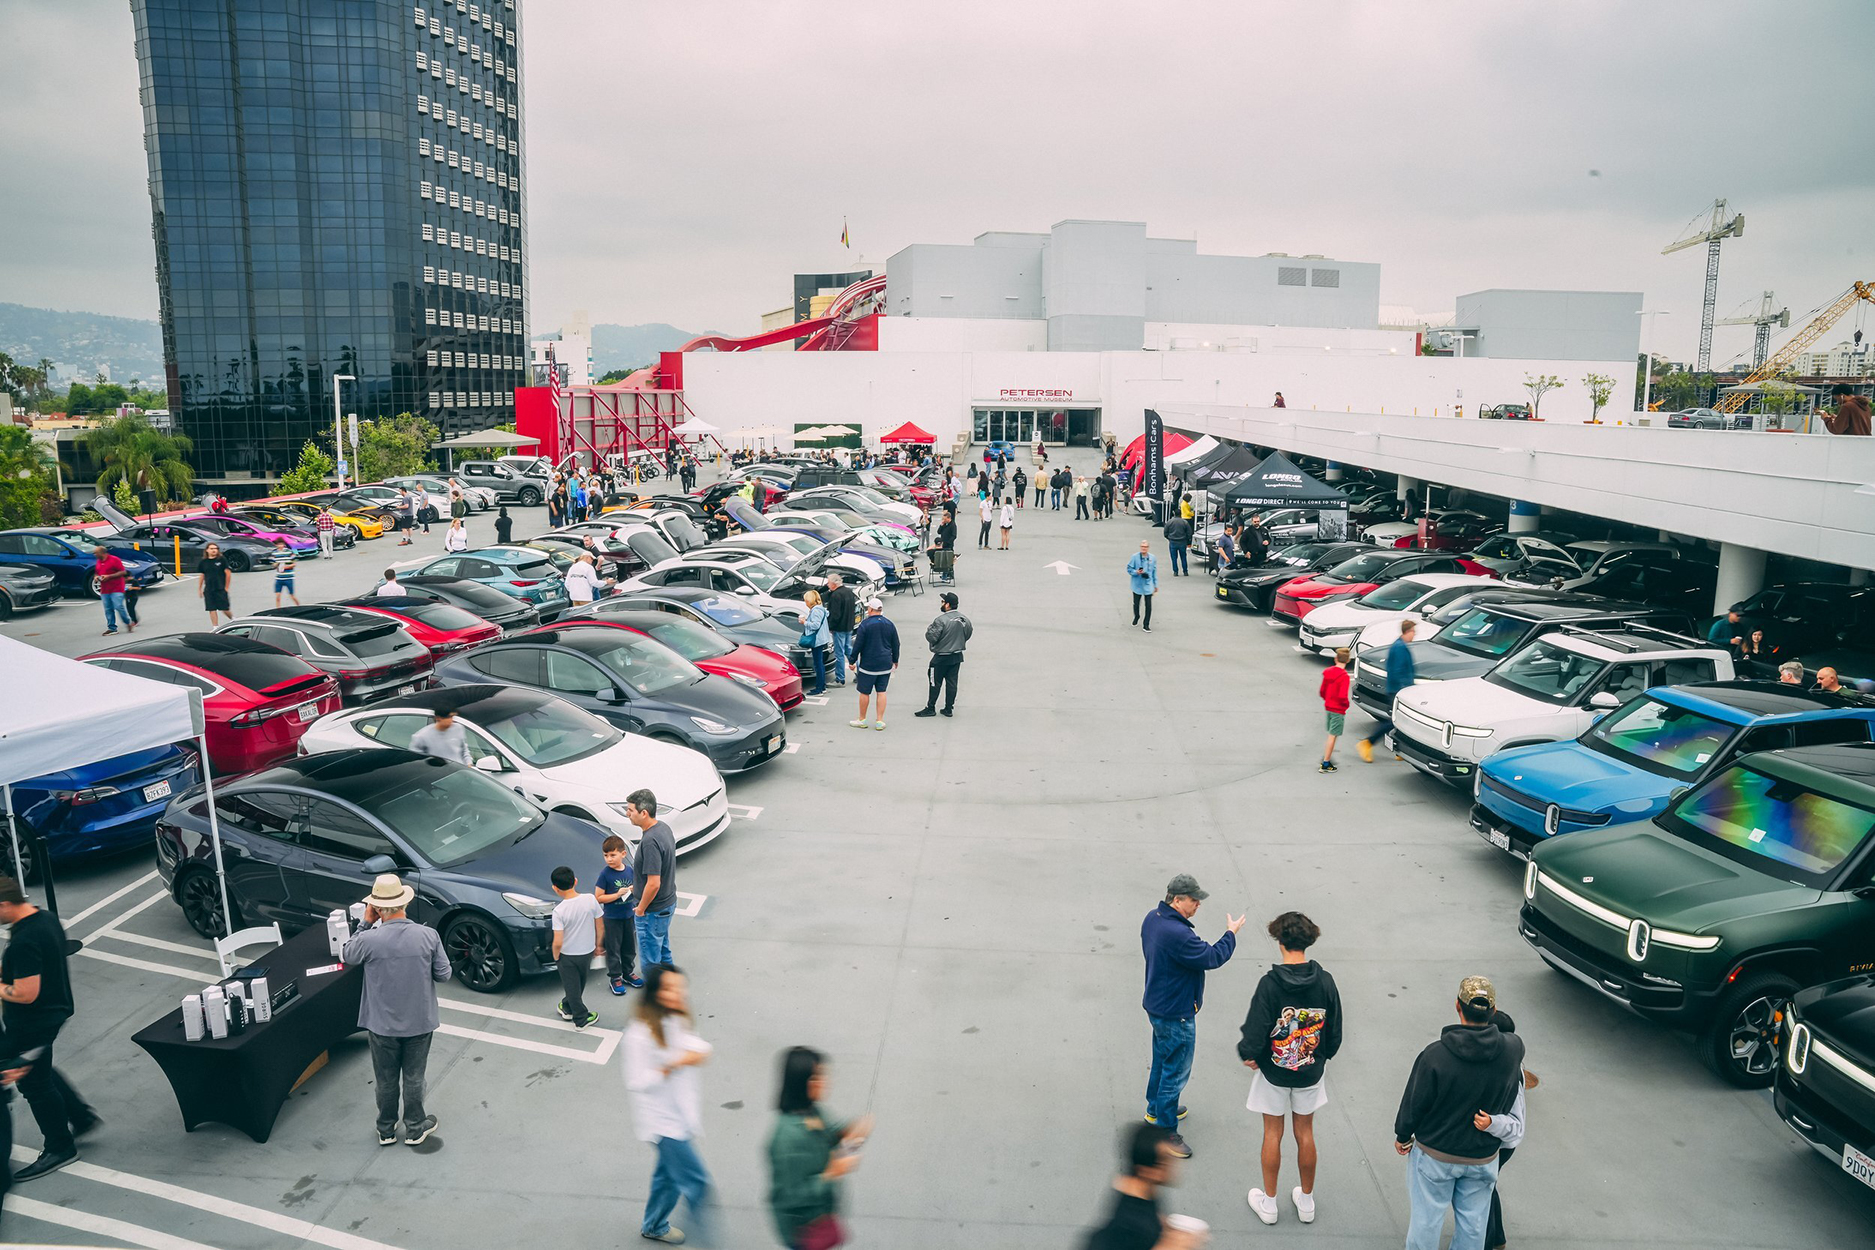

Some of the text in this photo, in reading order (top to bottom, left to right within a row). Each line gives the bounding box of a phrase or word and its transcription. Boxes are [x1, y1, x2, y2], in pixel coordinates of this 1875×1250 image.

[1000, 389, 1073, 397] PETERSEN
[1148, 419, 1158, 495] Bonhams Cars
